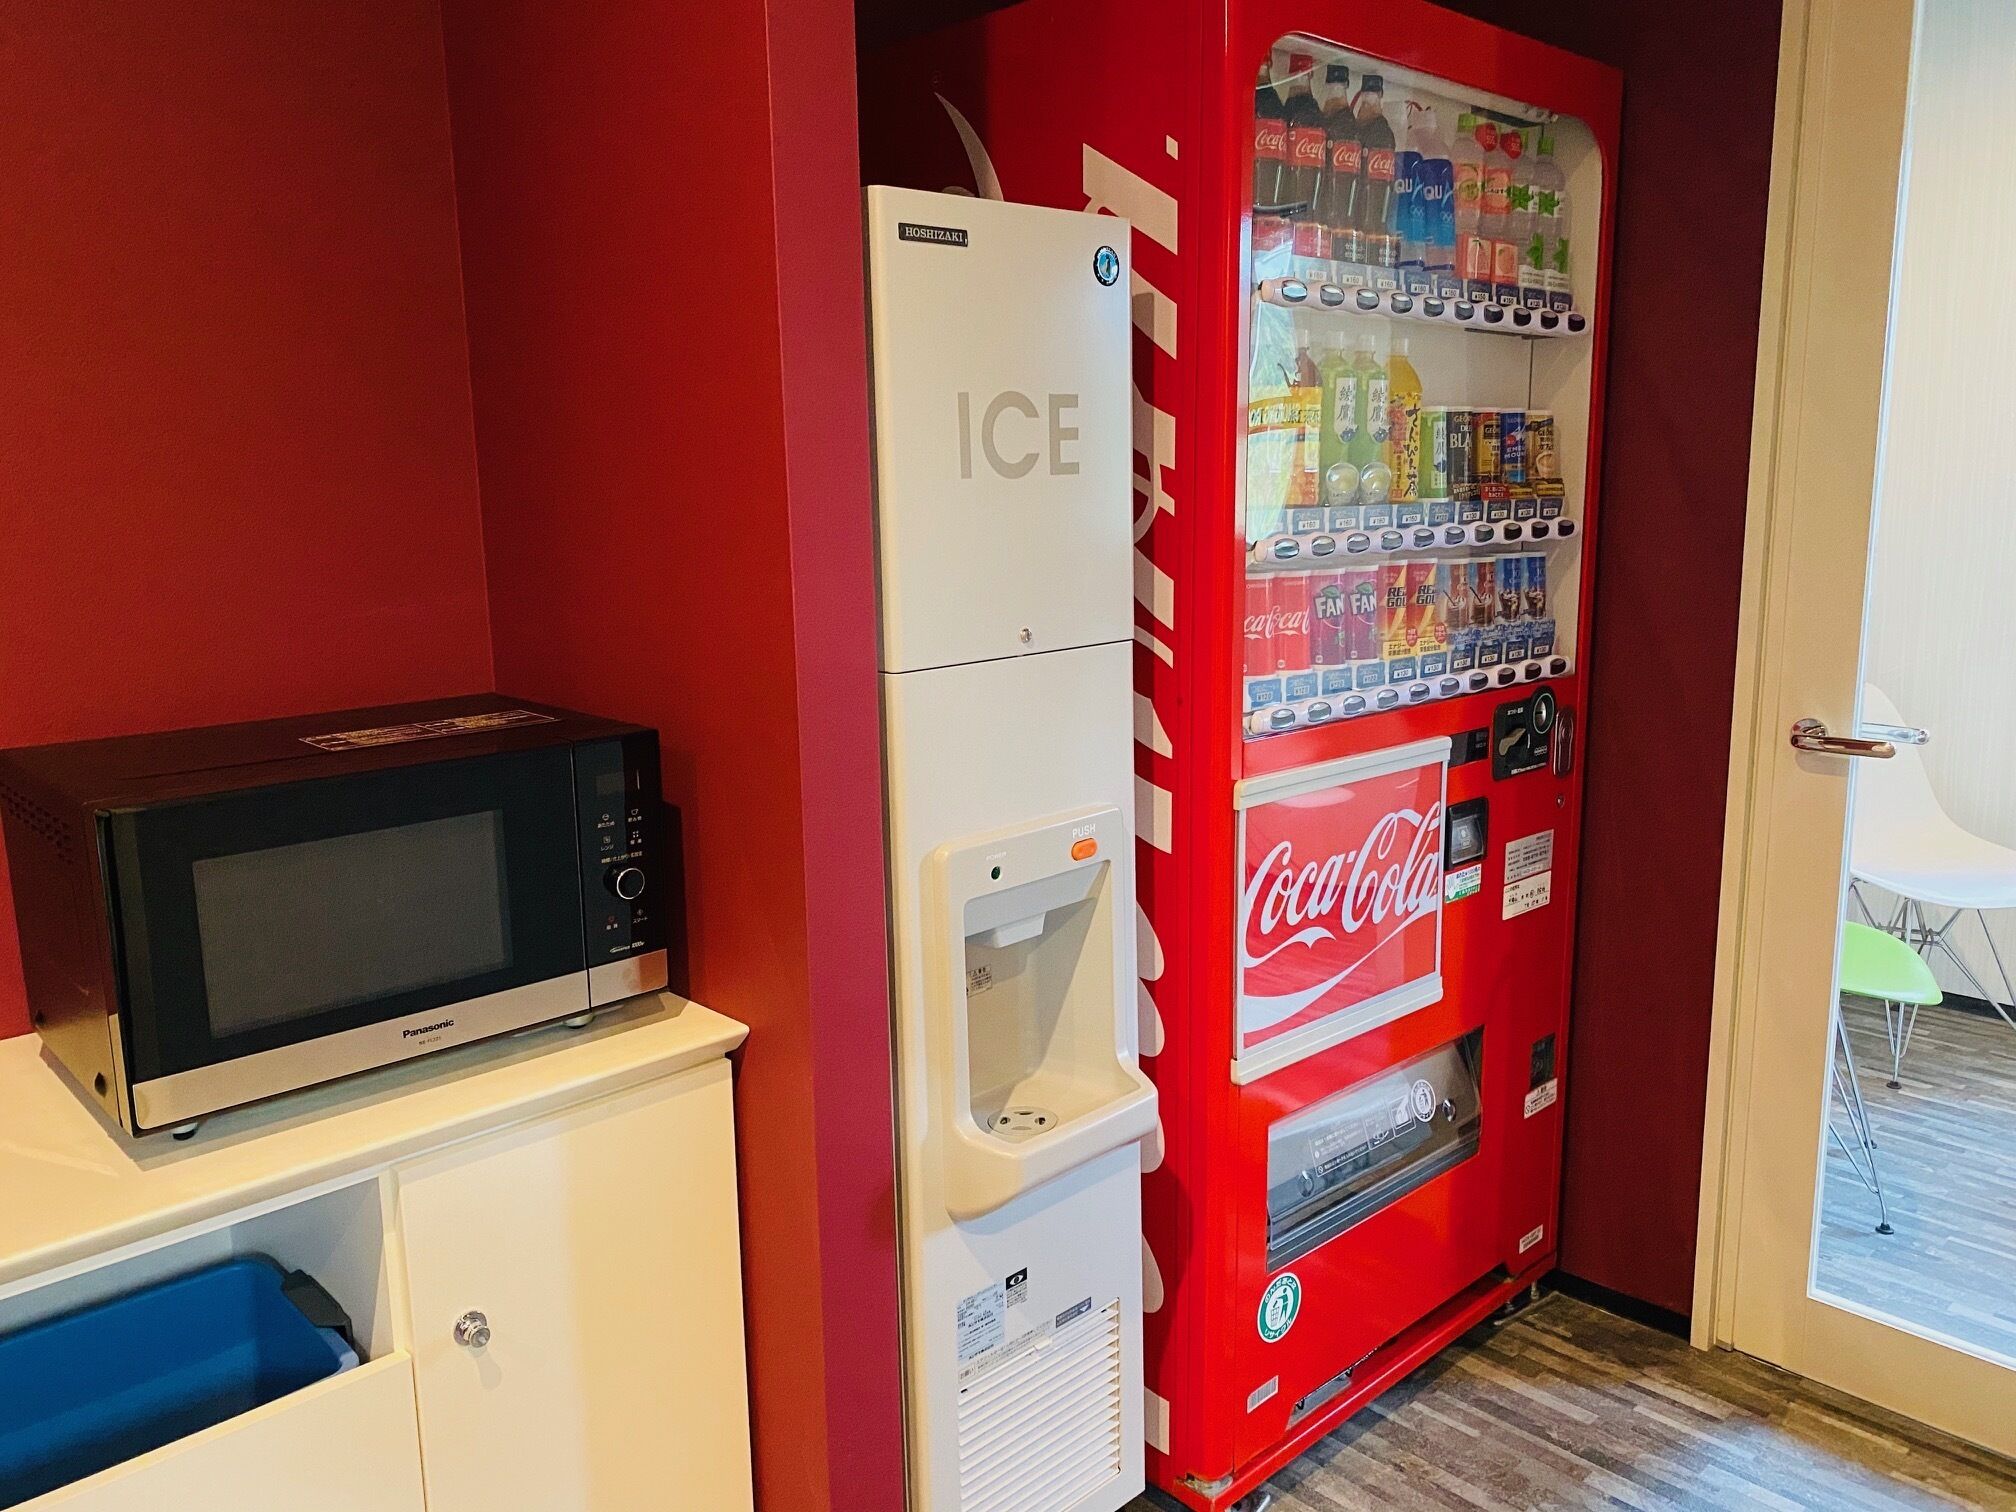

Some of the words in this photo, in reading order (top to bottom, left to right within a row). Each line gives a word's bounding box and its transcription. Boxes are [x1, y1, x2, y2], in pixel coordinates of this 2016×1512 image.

[905, 226, 963, 242] HOSHIZAKI
[957, 390, 1080, 479] ICE
[1072, 824, 1096, 838] PUSH
[1245, 801, 1440, 964] Coca-Cola
[402, 1019, 454, 1039] Panasonic
